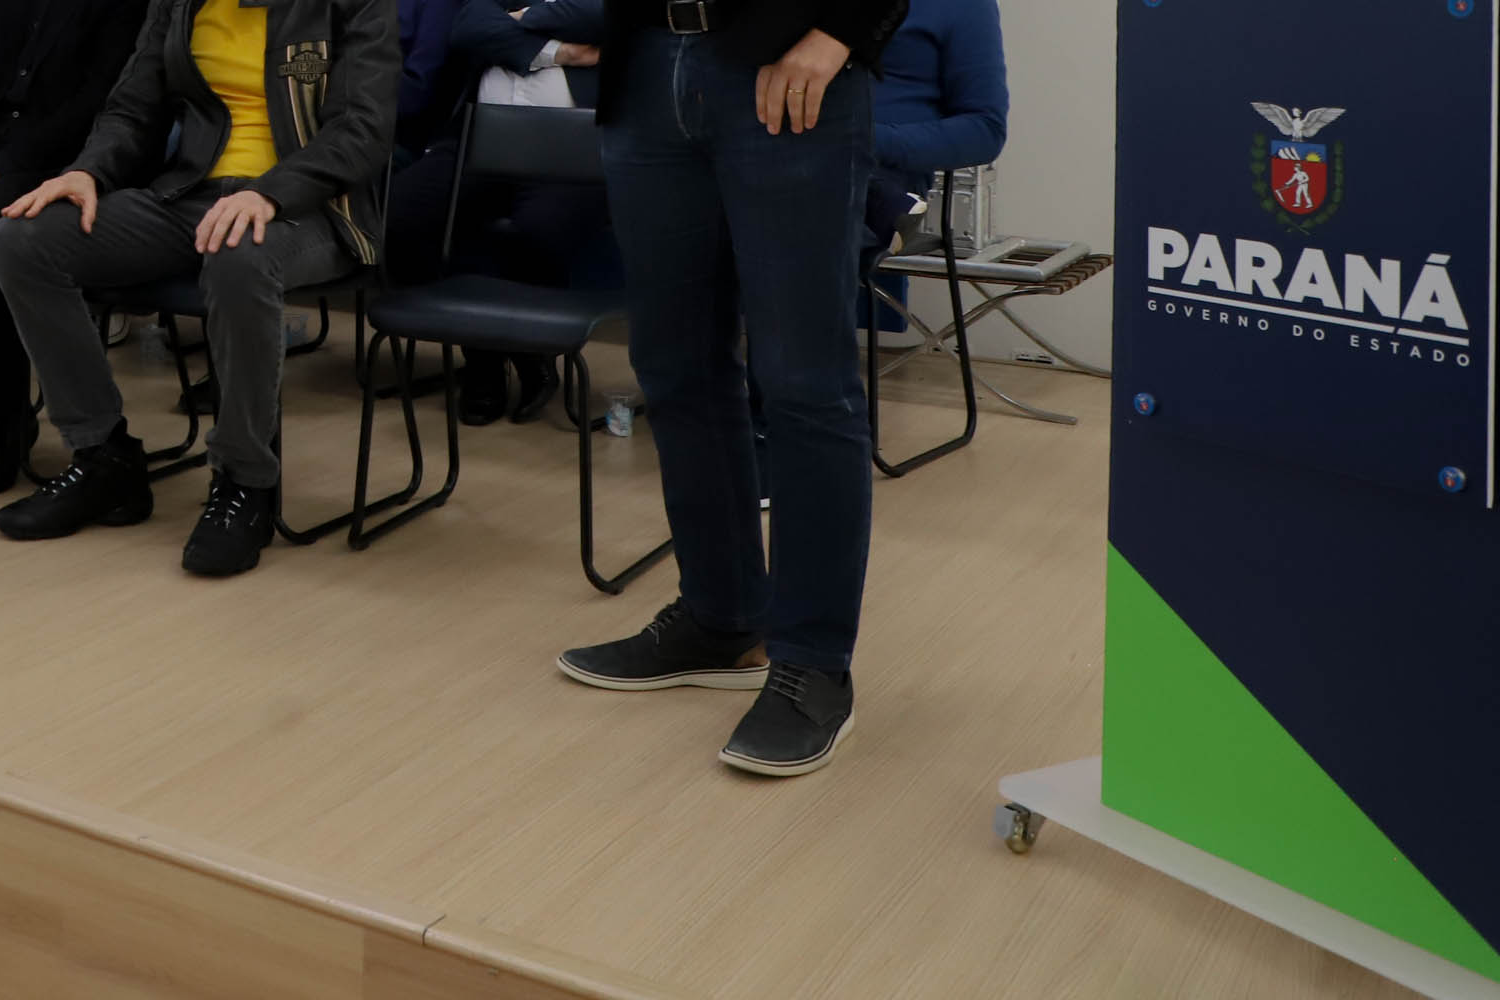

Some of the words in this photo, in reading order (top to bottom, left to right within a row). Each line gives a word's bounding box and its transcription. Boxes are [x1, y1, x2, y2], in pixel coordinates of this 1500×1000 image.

[1148, 226, 1469, 330] PARANÁ
[1147, 299, 1269, 332] GOVERNO
[1293, 324, 1325, 341] DO
[1350, 335, 1470, 367] ESTADO
